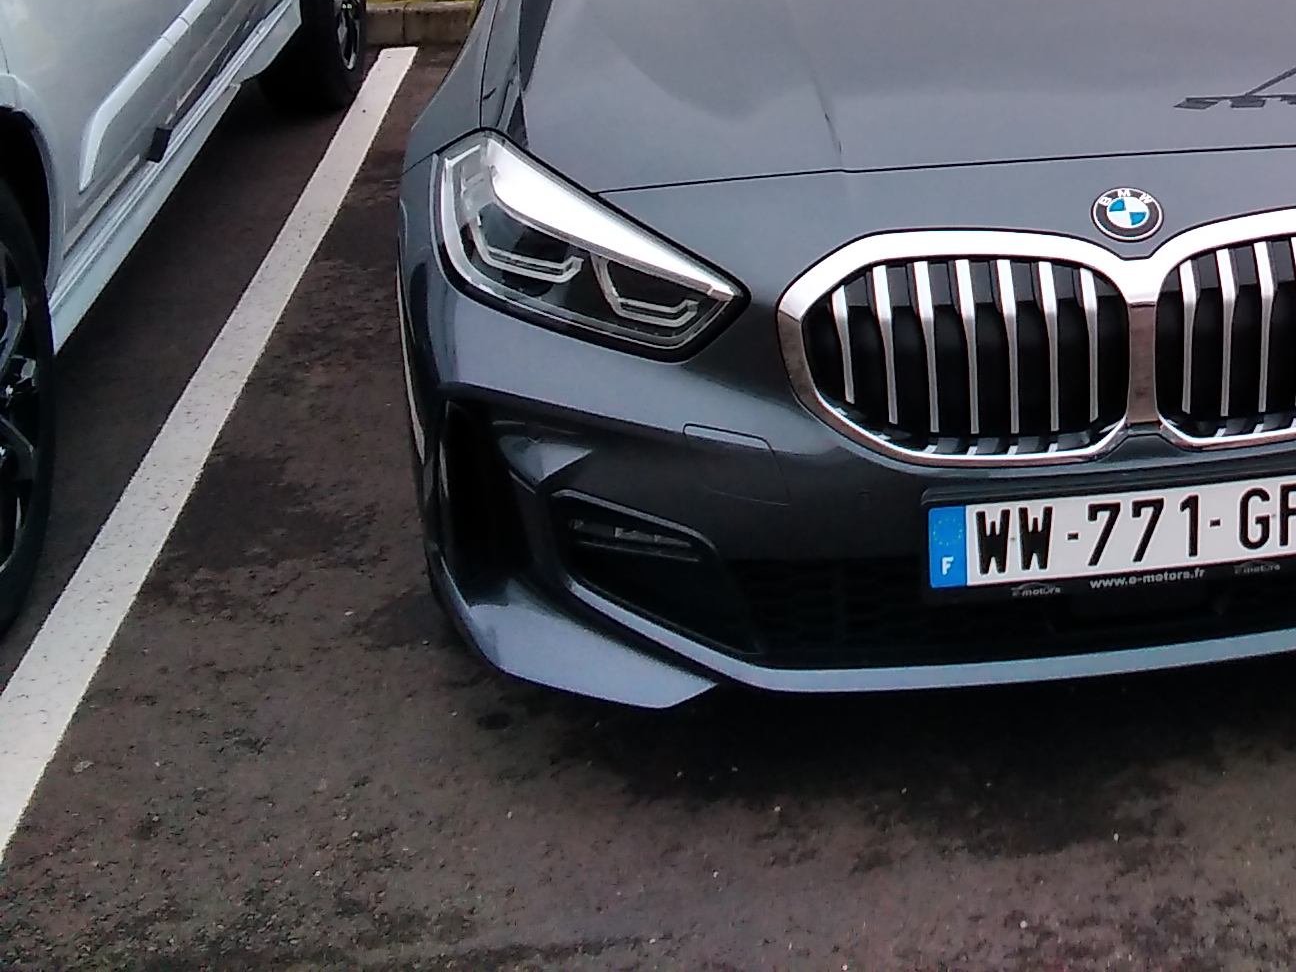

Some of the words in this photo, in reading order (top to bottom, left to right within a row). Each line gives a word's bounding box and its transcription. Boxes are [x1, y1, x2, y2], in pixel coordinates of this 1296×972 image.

[1098, 188, 1153, 207] BMW
[941, 556, 955, 576] F
[1089, 567, 1205, 590] www.e-motors.fr
